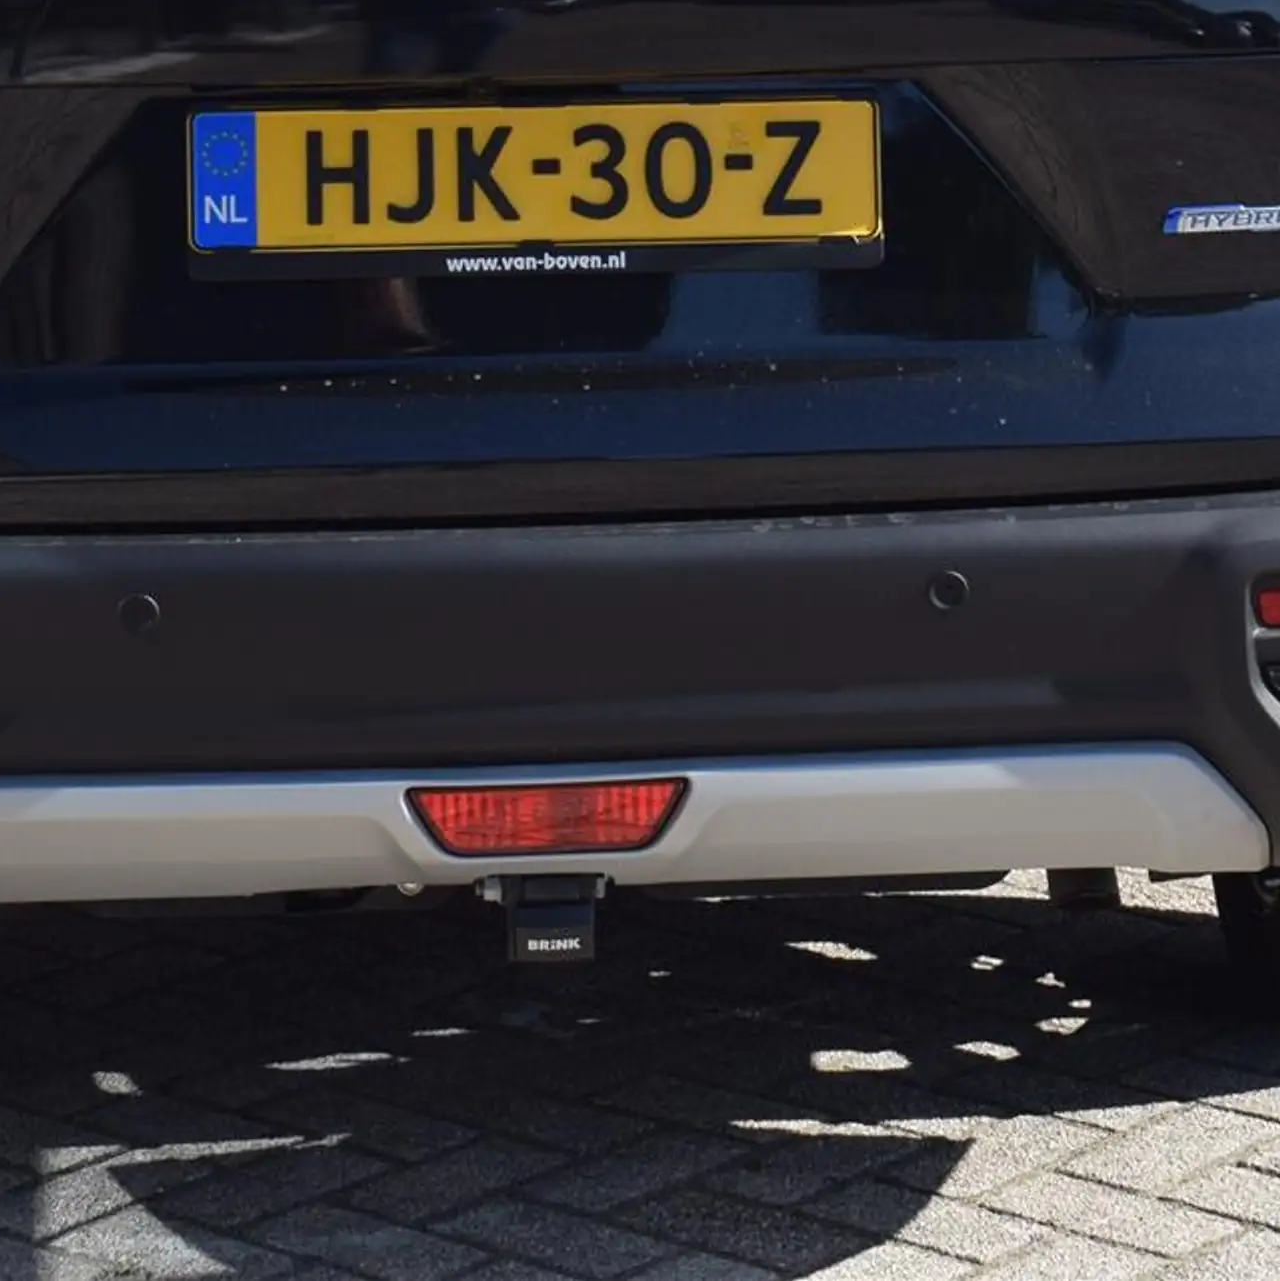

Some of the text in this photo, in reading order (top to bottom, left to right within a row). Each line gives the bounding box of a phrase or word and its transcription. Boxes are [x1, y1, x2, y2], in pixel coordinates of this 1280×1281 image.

[306, 121, 823, 225] HJK-30-Z
[203, 194, 249, 225] NL
[446, 250, 626, 273] www.van-boven.nl
